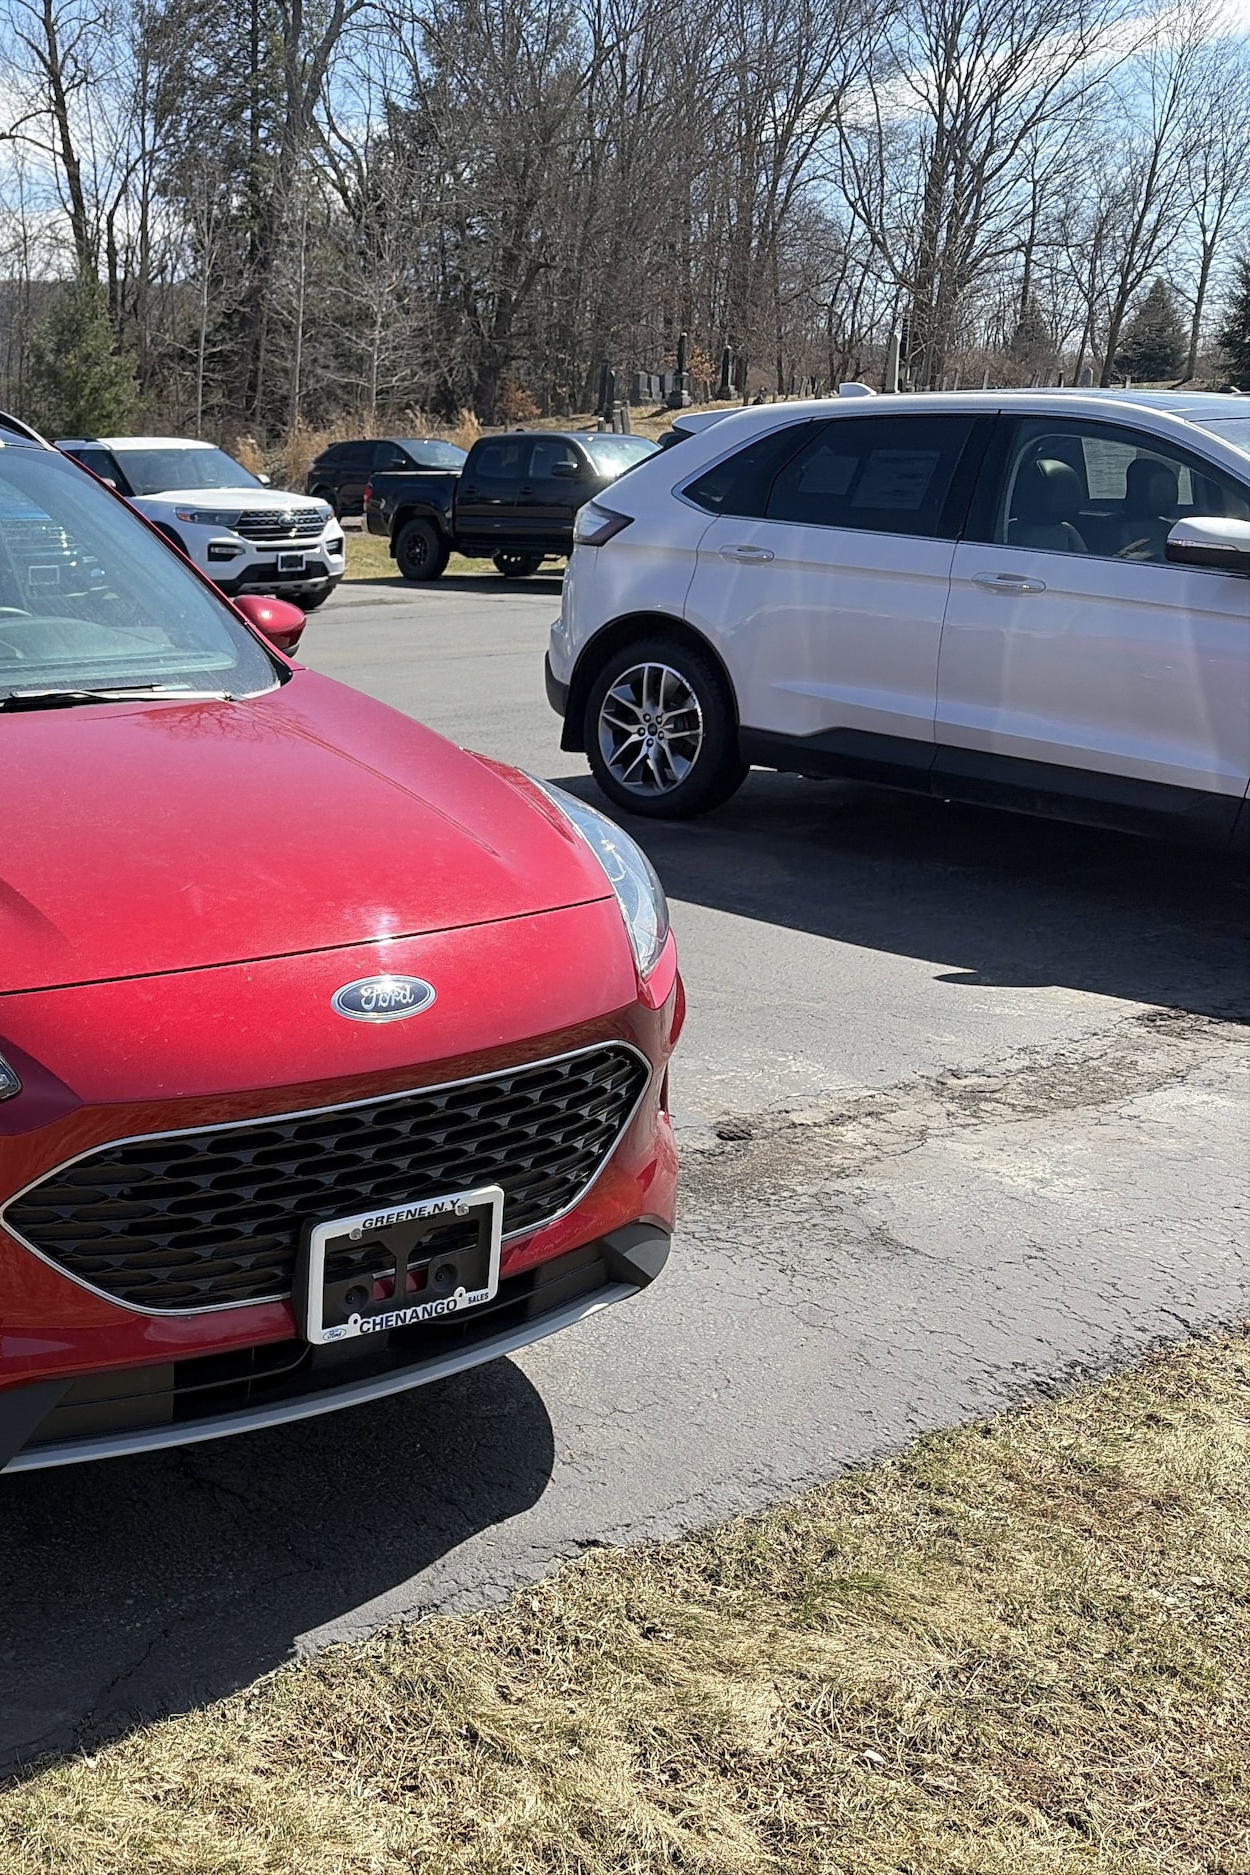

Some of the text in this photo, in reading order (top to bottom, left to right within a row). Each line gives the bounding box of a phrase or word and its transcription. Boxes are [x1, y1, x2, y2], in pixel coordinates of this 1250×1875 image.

[360, 983, 414, 1010] Ford
[359, 1293, 489, 1333] CHENANGO SALES
